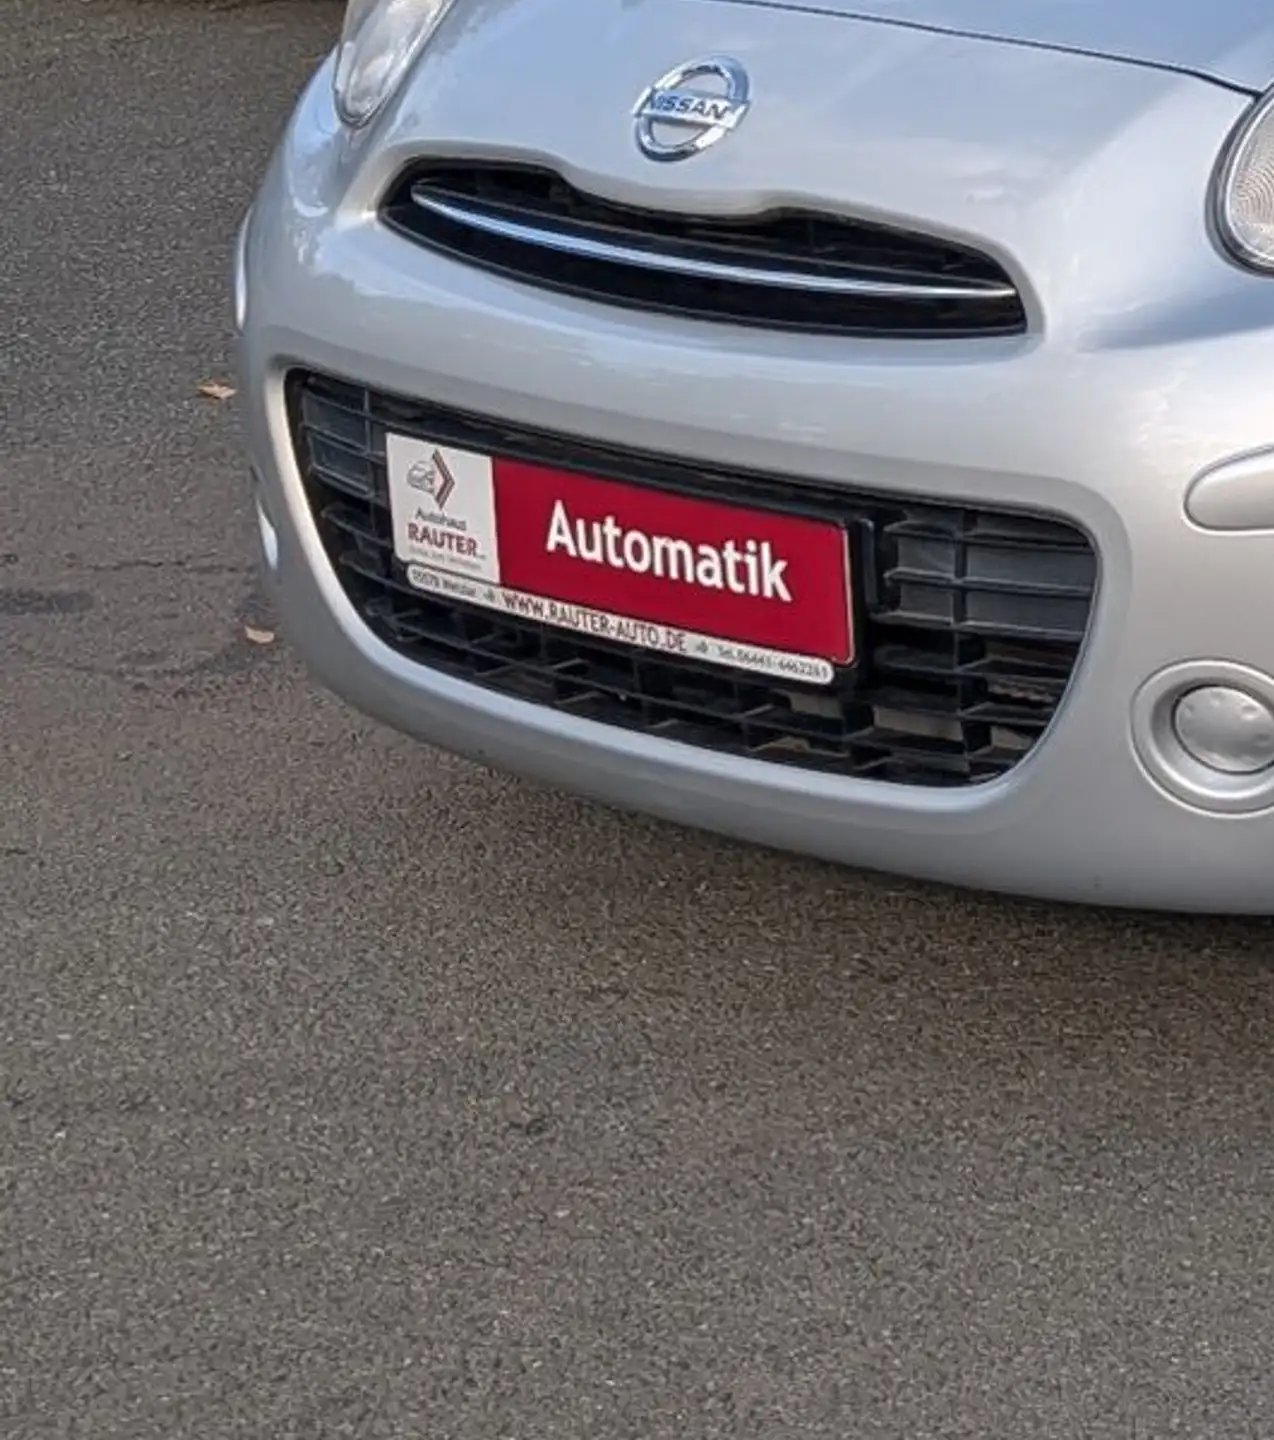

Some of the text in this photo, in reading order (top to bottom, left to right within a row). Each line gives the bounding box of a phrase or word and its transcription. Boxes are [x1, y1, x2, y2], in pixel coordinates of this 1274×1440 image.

[652, 94, 730, 120] NISSAN
[408, 523, 477, 557] RAUTER
[546, 499, 792, 602] Automatik
[501, 590, 687, 652] WWW.RAUTER-AUTO.DE
